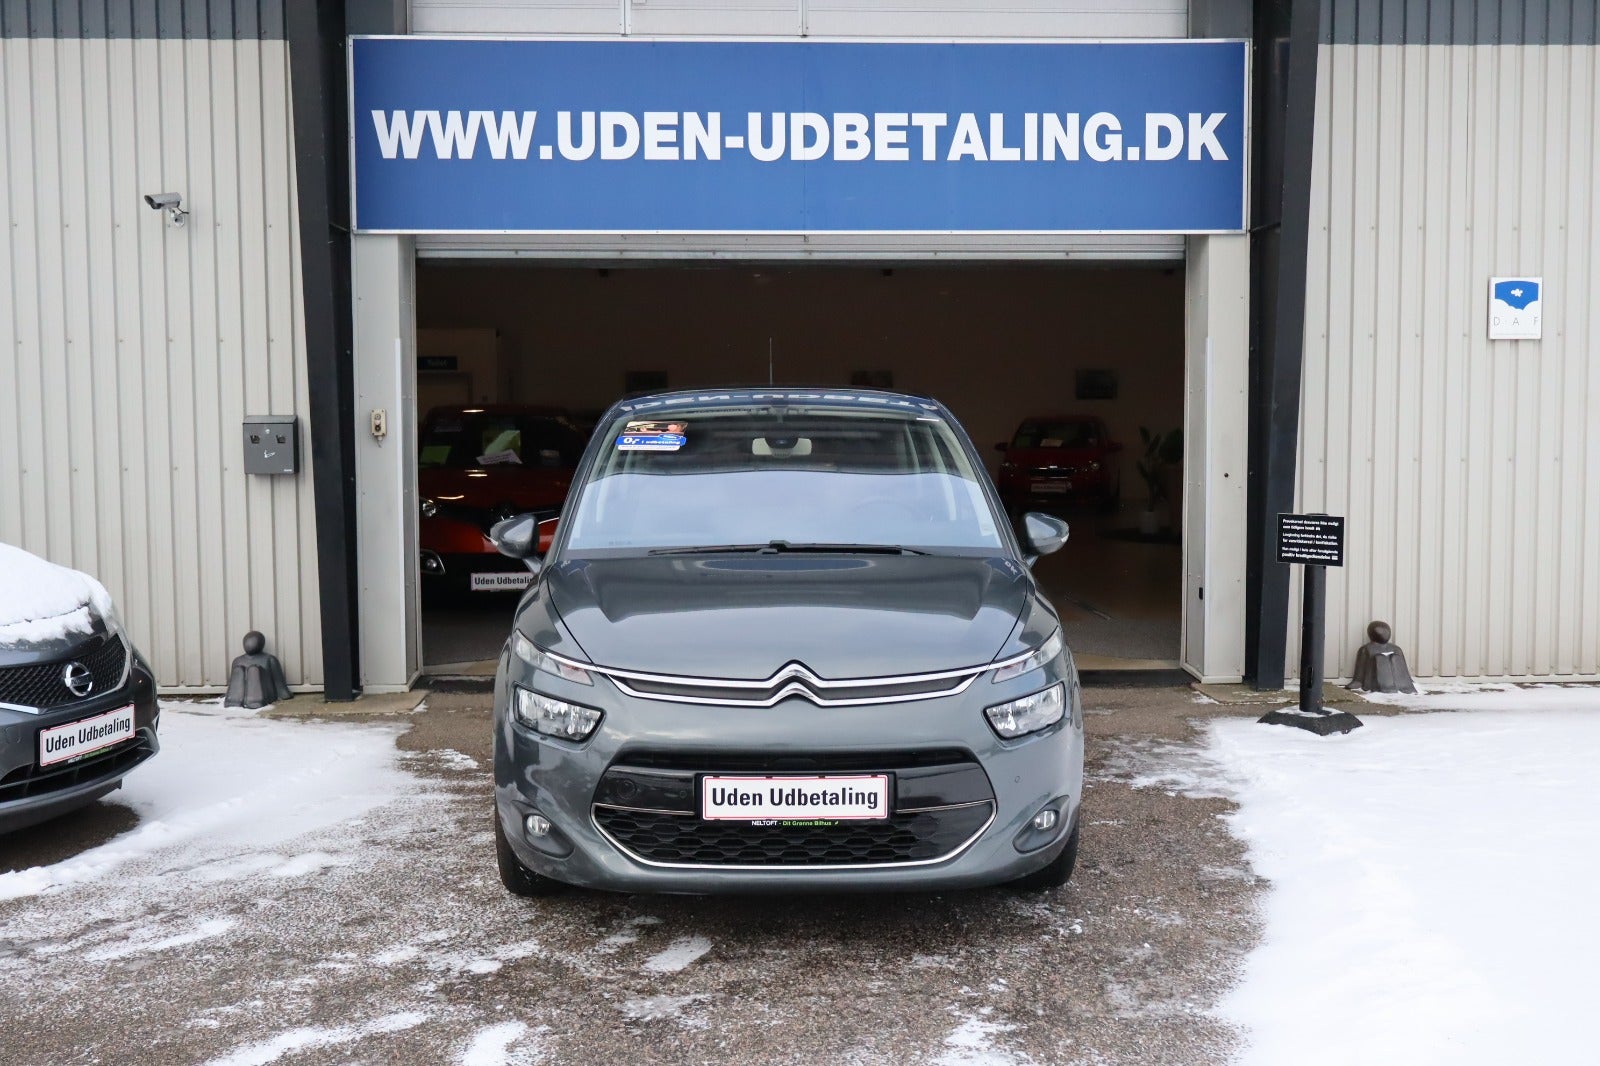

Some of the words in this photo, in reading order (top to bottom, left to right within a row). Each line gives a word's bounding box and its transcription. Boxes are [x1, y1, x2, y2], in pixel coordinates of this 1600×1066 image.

[370, 109, 1229, 162] WWW.UDEN-UDBETALING.DK
[46, 733, 74, 753] Uden
[78, 718, 130, 744] Udbetaling
[712, 788, 763, 806] Uden
[770, 788, 878, 810] Udbetaling
